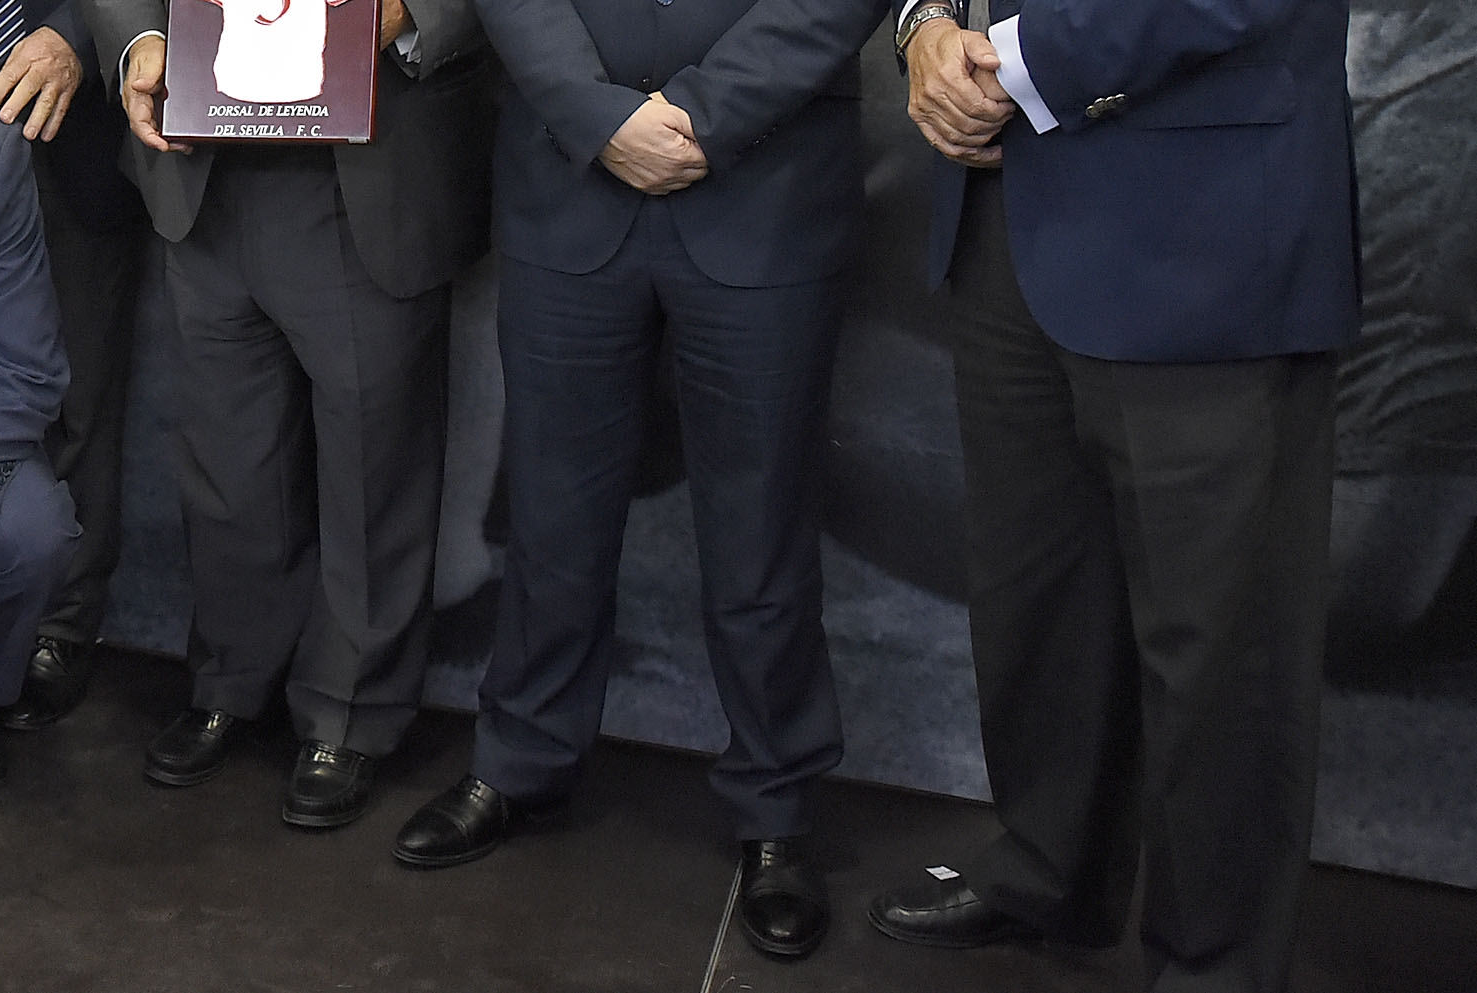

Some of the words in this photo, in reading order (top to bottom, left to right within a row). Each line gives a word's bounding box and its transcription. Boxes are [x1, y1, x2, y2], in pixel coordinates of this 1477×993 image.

[208, 105, 254, 117] DORSAL
[258, 105, 274, 117] DE
[276, 105, 329, 117] LEYENDA
[214, 125, 236, 136] DEL
[239, 125, 284, 136] SEVILLA
[310, 125, 323, 137] C.
